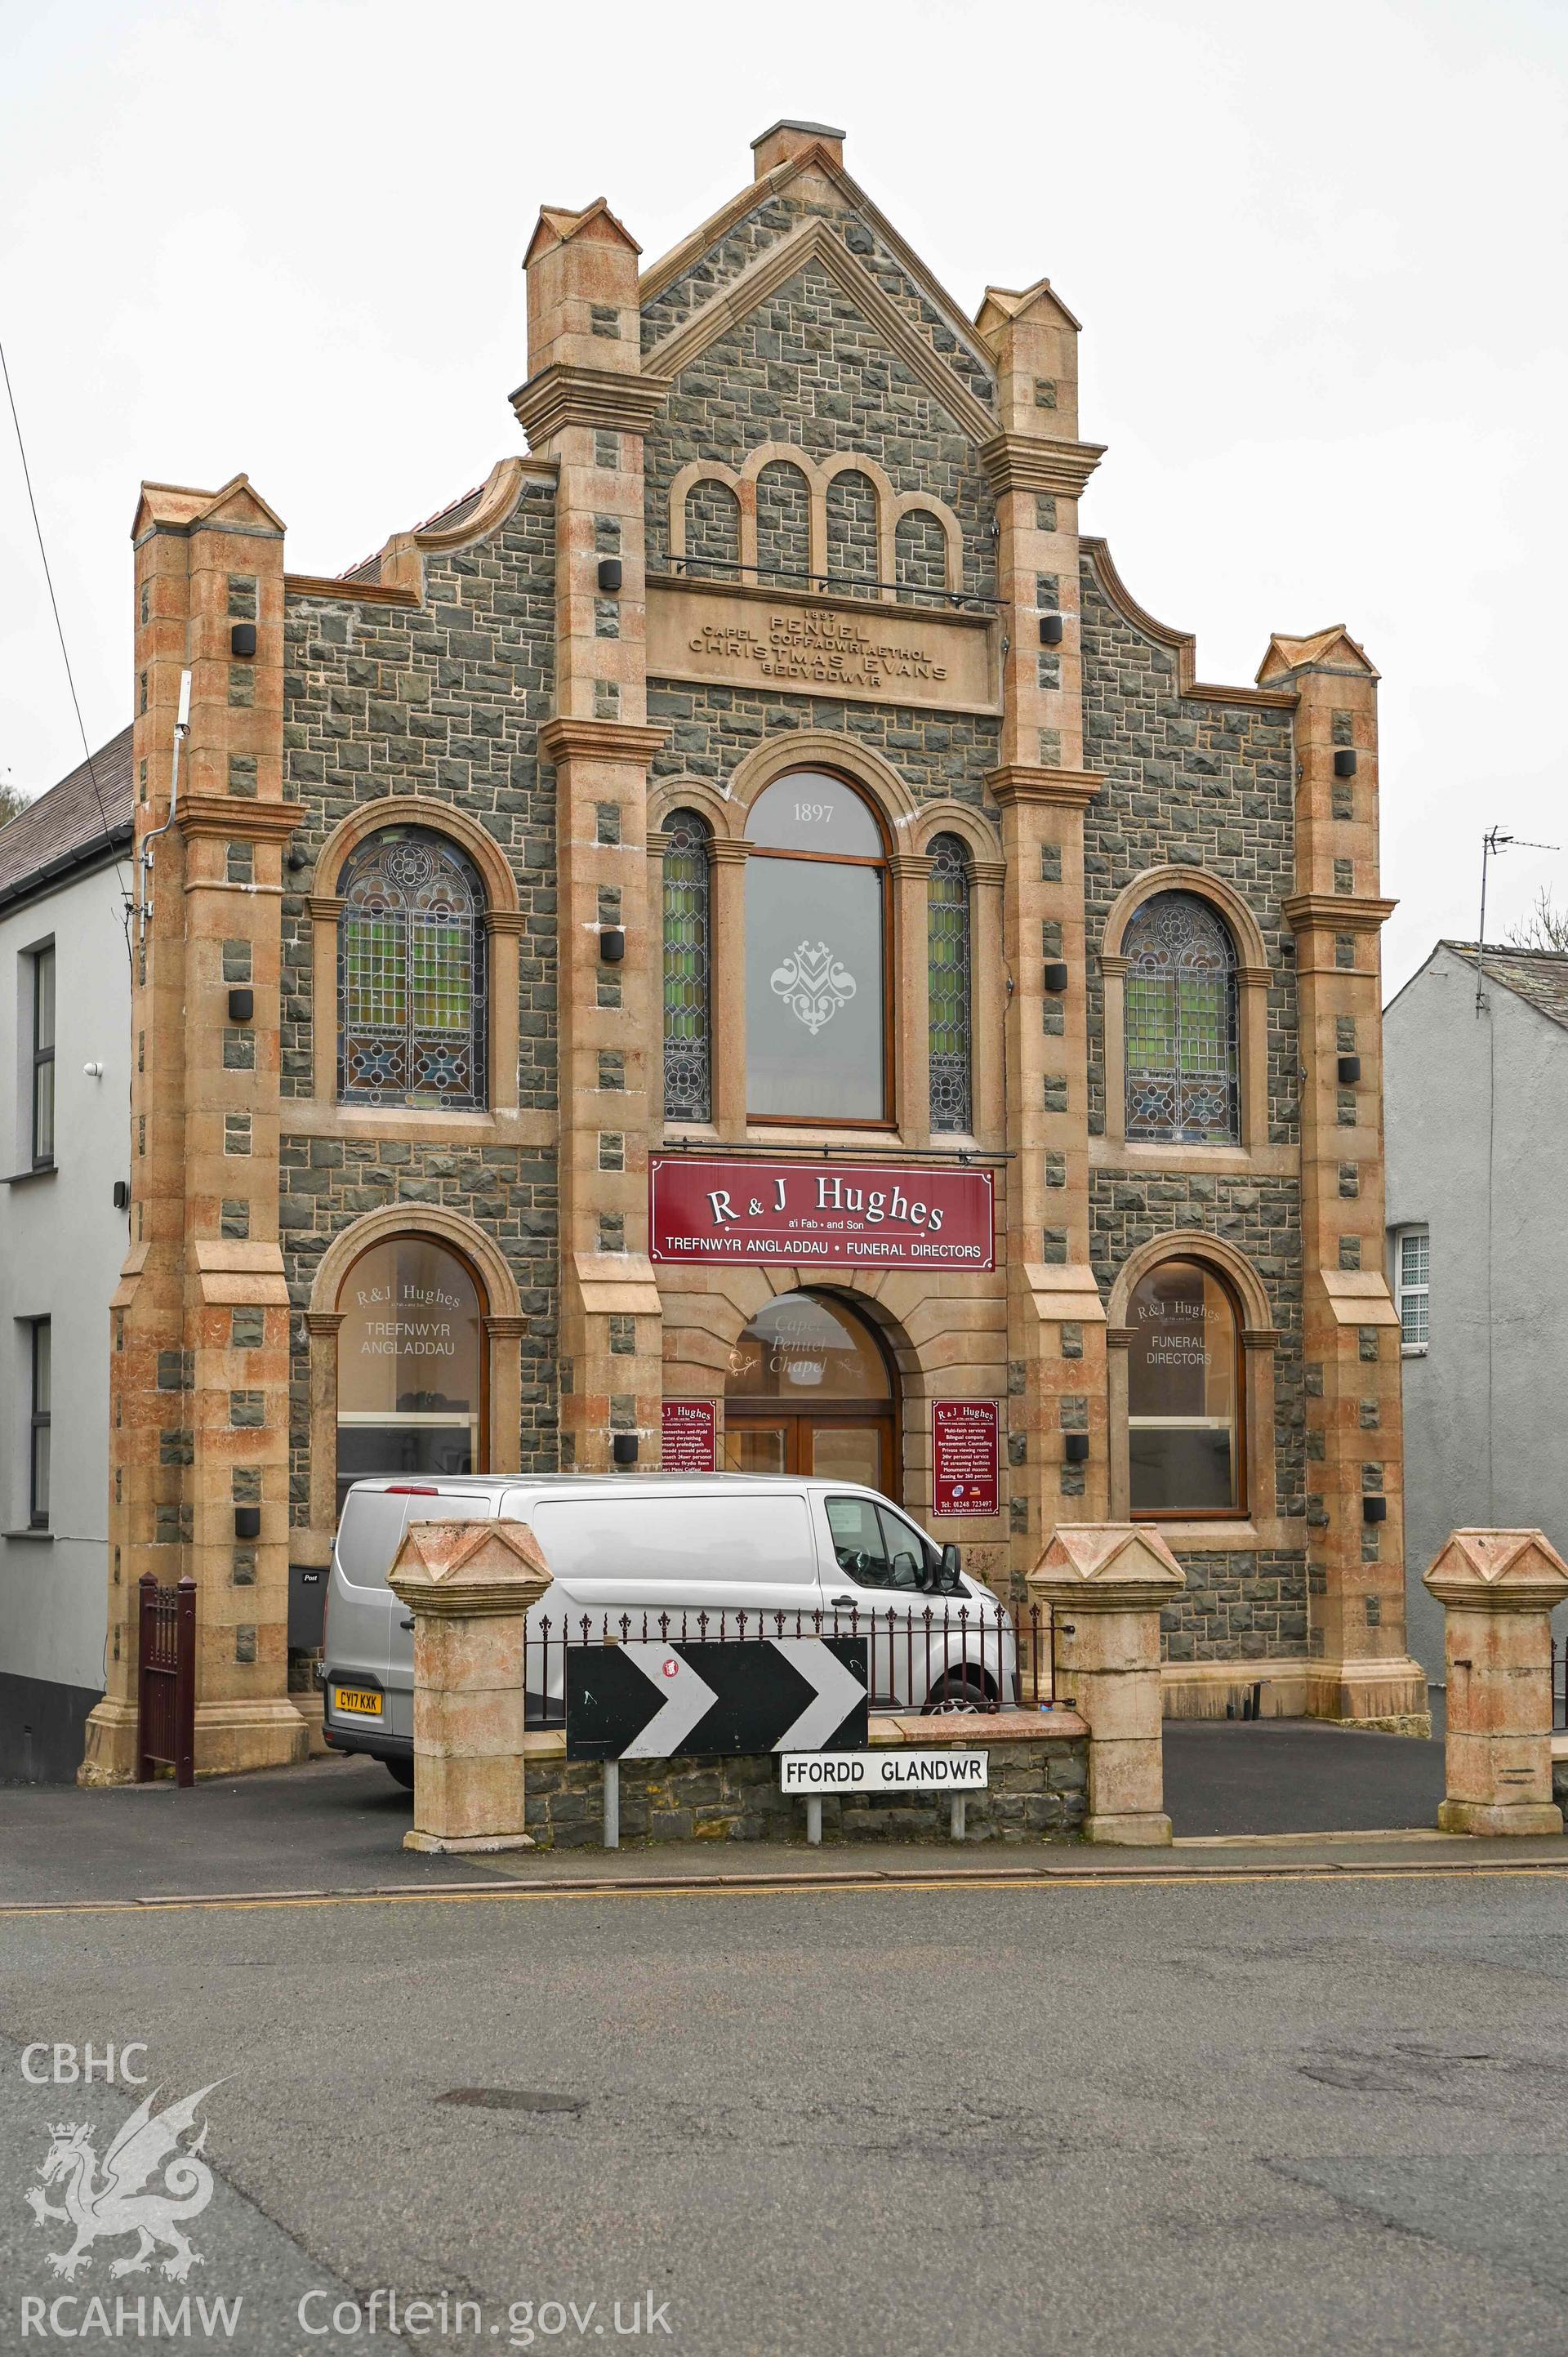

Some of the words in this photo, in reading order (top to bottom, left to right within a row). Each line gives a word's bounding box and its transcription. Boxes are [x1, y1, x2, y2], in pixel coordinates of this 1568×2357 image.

[805, 610, 836, 622] 1897
[770, 616, 870, 642] PENUEL
[702, 626, 758, 642] CAPEL
[769, 633, 933, 662] COFFADWRIAETHOL
[690, 639, 844, 668] CHRISTMAS
[864, 657, 948, 680] EVANS
[761, 663, 882, 686] BEDYDDWYR
[794, 804, 834, 822] 1897
[707, 1190, 740, 1224] R
[748, 1198, 764, 1215] &
[774, 1178, 787, 1211] J
[816, 1177, 944, 1230] Hughes
[801, 1219, 817, 1228] Fab
[826, 1220, 844, 1228] and
[846, 1220, 864, 1229] Son
[666, 1237, 742, 1251] TREFNWYR
[746, 1240, 828, 1254] ANGLADDAU
[847, 1242, 906, 1256] FUNERAL
[911, 1244, 981, 1258] DIRECTORS
[403, 1285, 461, 1308] Hughes
[1176, 1301, 1220, 1321] Hughes
[366, 1322, 450, 1336] TREFNWYR
[776, 1315, 821, 1335] Capel
[361, 1342, 455, 1355] ANGLADDAU
[772, 1335, 826, 1352] Penuel
[1152, 1336, 1206, 1348] FUNERAL
[770, 1356, 827, 1377] Chapel
[1147, 1353, 1212, 1365] DIRECTORS
[667, 1408, 670, 1416] J
[678, 1406, 710, 1419] Hughes
[938, 1411, 946, 1419] R
[953, 1407, 956, 1416] J
[964, 1407, 993, 1419] Hughes
[341, 1691, 359, 1707] CY17
[361, 1694, 376, 1711] KXK
[787, 1762, 865, 1783] FFORDD
[881, 1760, 982, 1781] GLANDWR
